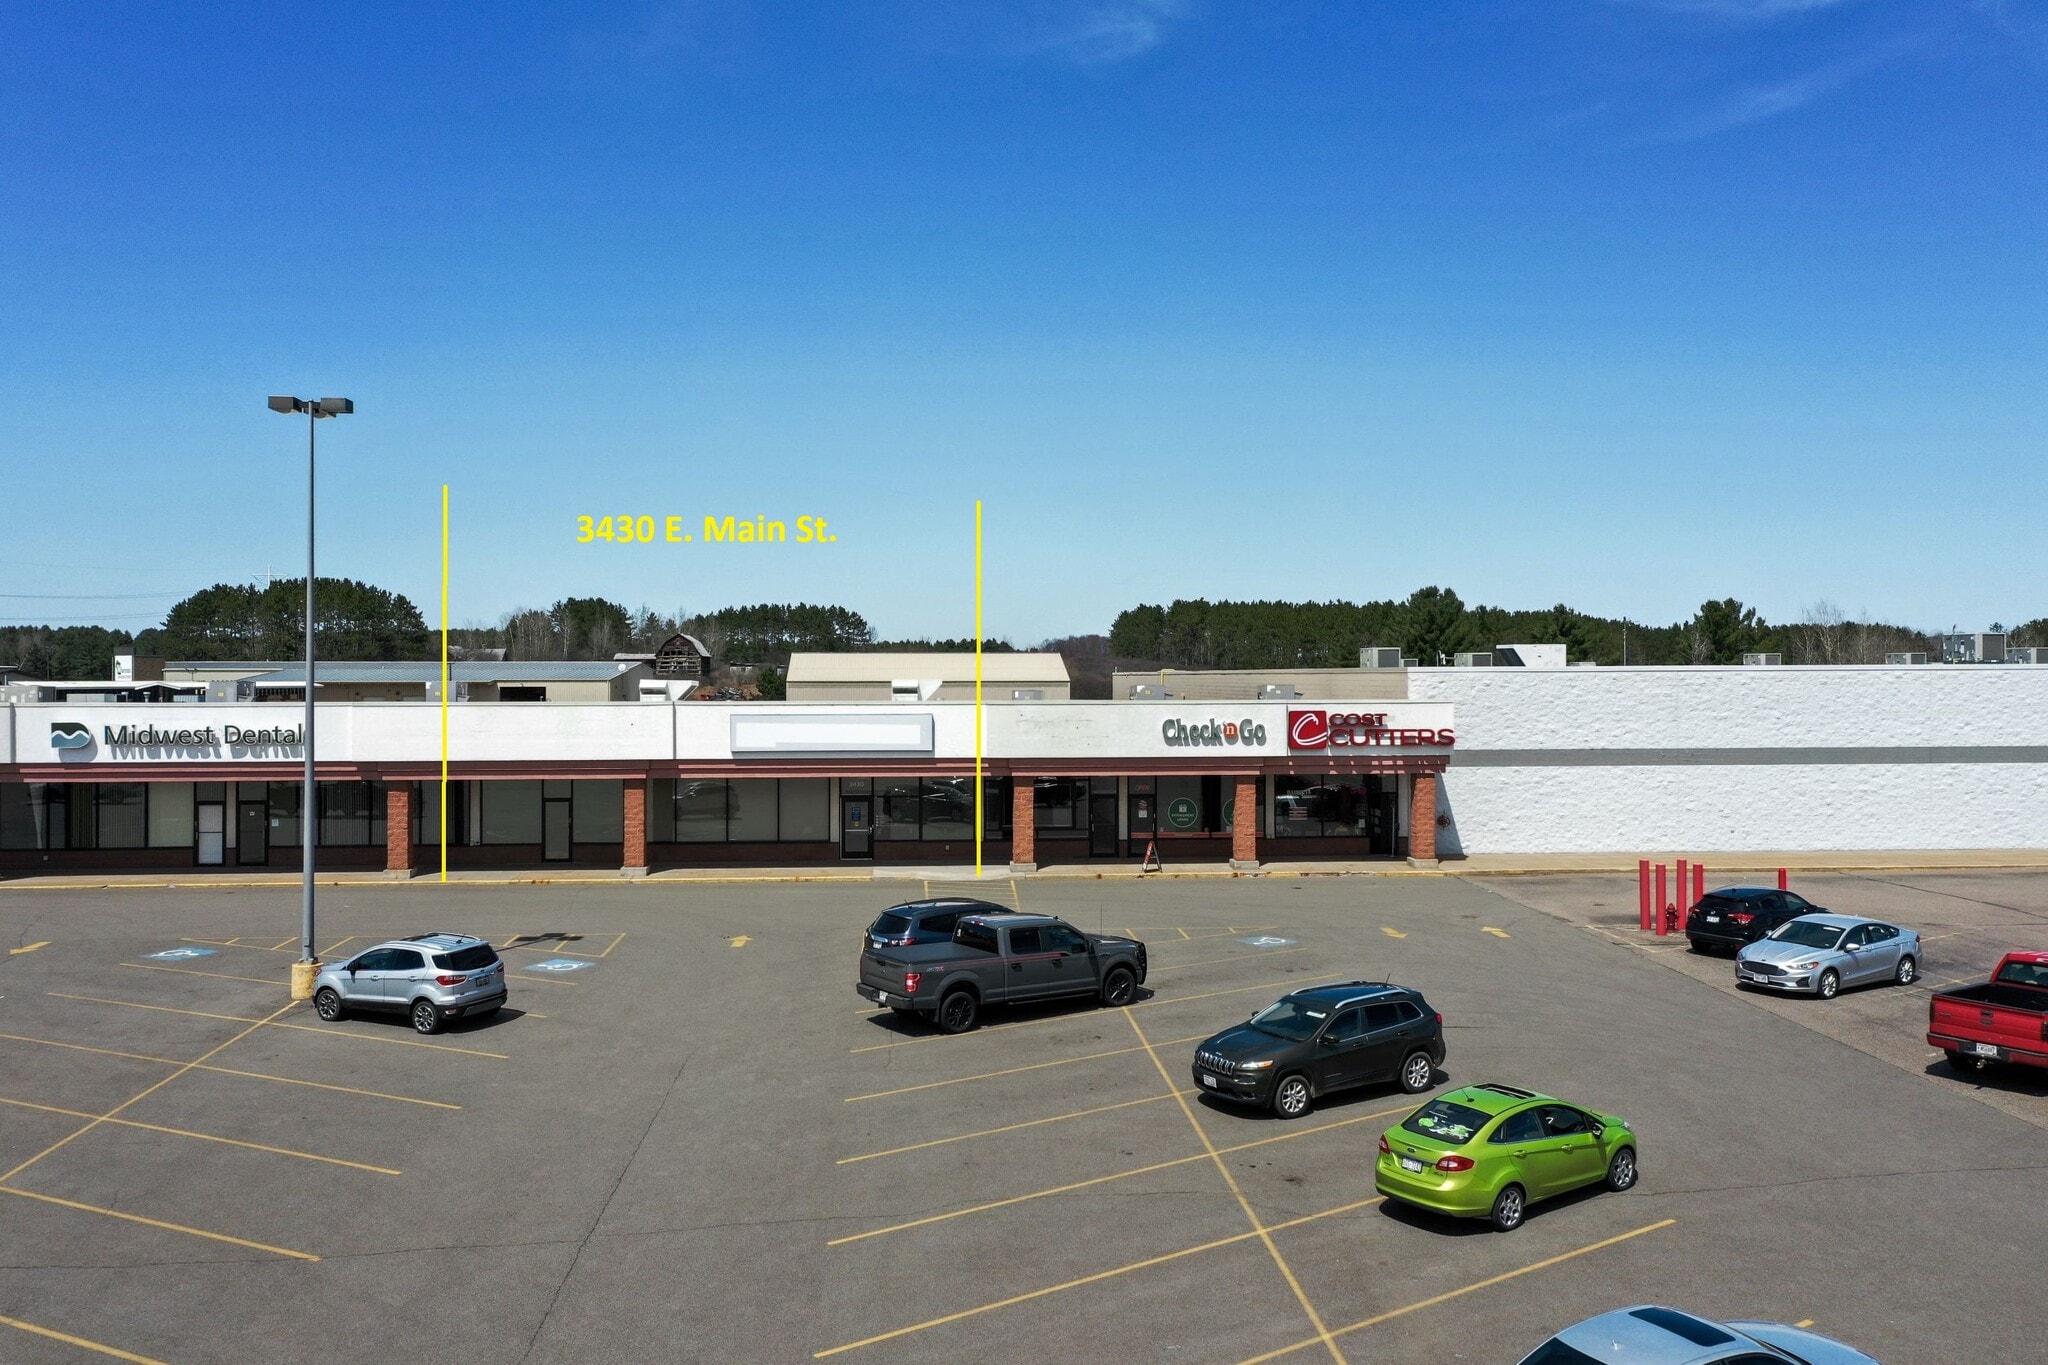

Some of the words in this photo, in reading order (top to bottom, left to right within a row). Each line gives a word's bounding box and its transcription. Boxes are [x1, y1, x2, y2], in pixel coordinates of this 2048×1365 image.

[1162, 718, 1223, 742] Check
[1239, 718, 1266, 742] Go
[1328, 713, 1388, 727] COST
[104, 723, 214, 745] Midwest
[224, 723, 303, 745] Dental
[1328, 728, 1456, 747] CUTTERS
